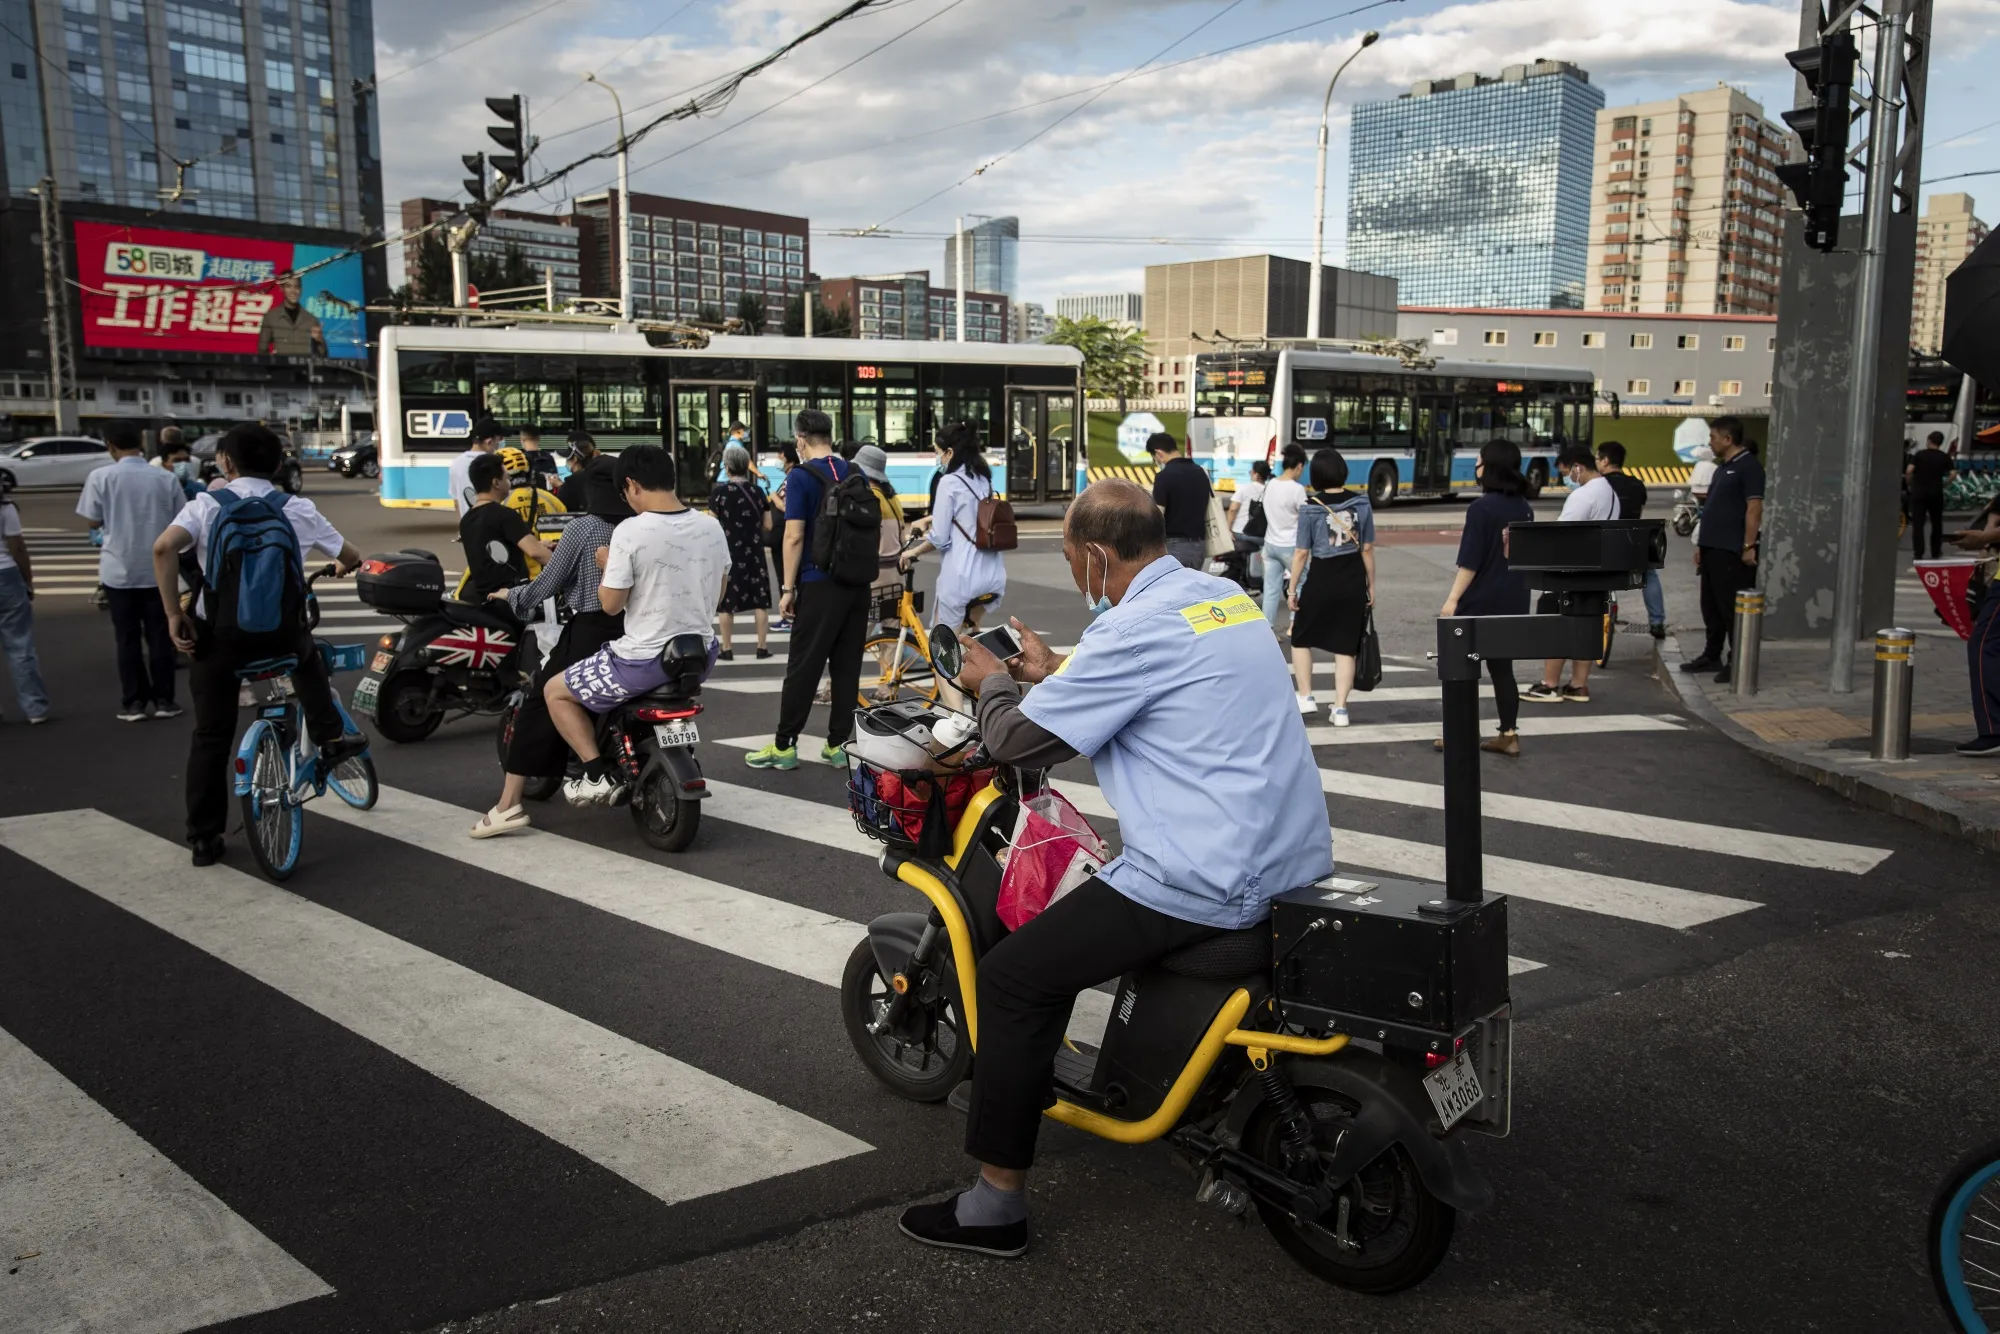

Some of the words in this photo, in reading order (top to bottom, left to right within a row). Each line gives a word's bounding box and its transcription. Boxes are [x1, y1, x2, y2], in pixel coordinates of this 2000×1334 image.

[115, 247, 195, 277] 58同城
[96, 282, 273, 334] 工作超多
[857, 366, 876, 378] 109
[661, 732, 697, 745] 868799
[1440, 1077, 1480, 1121] AW3068
